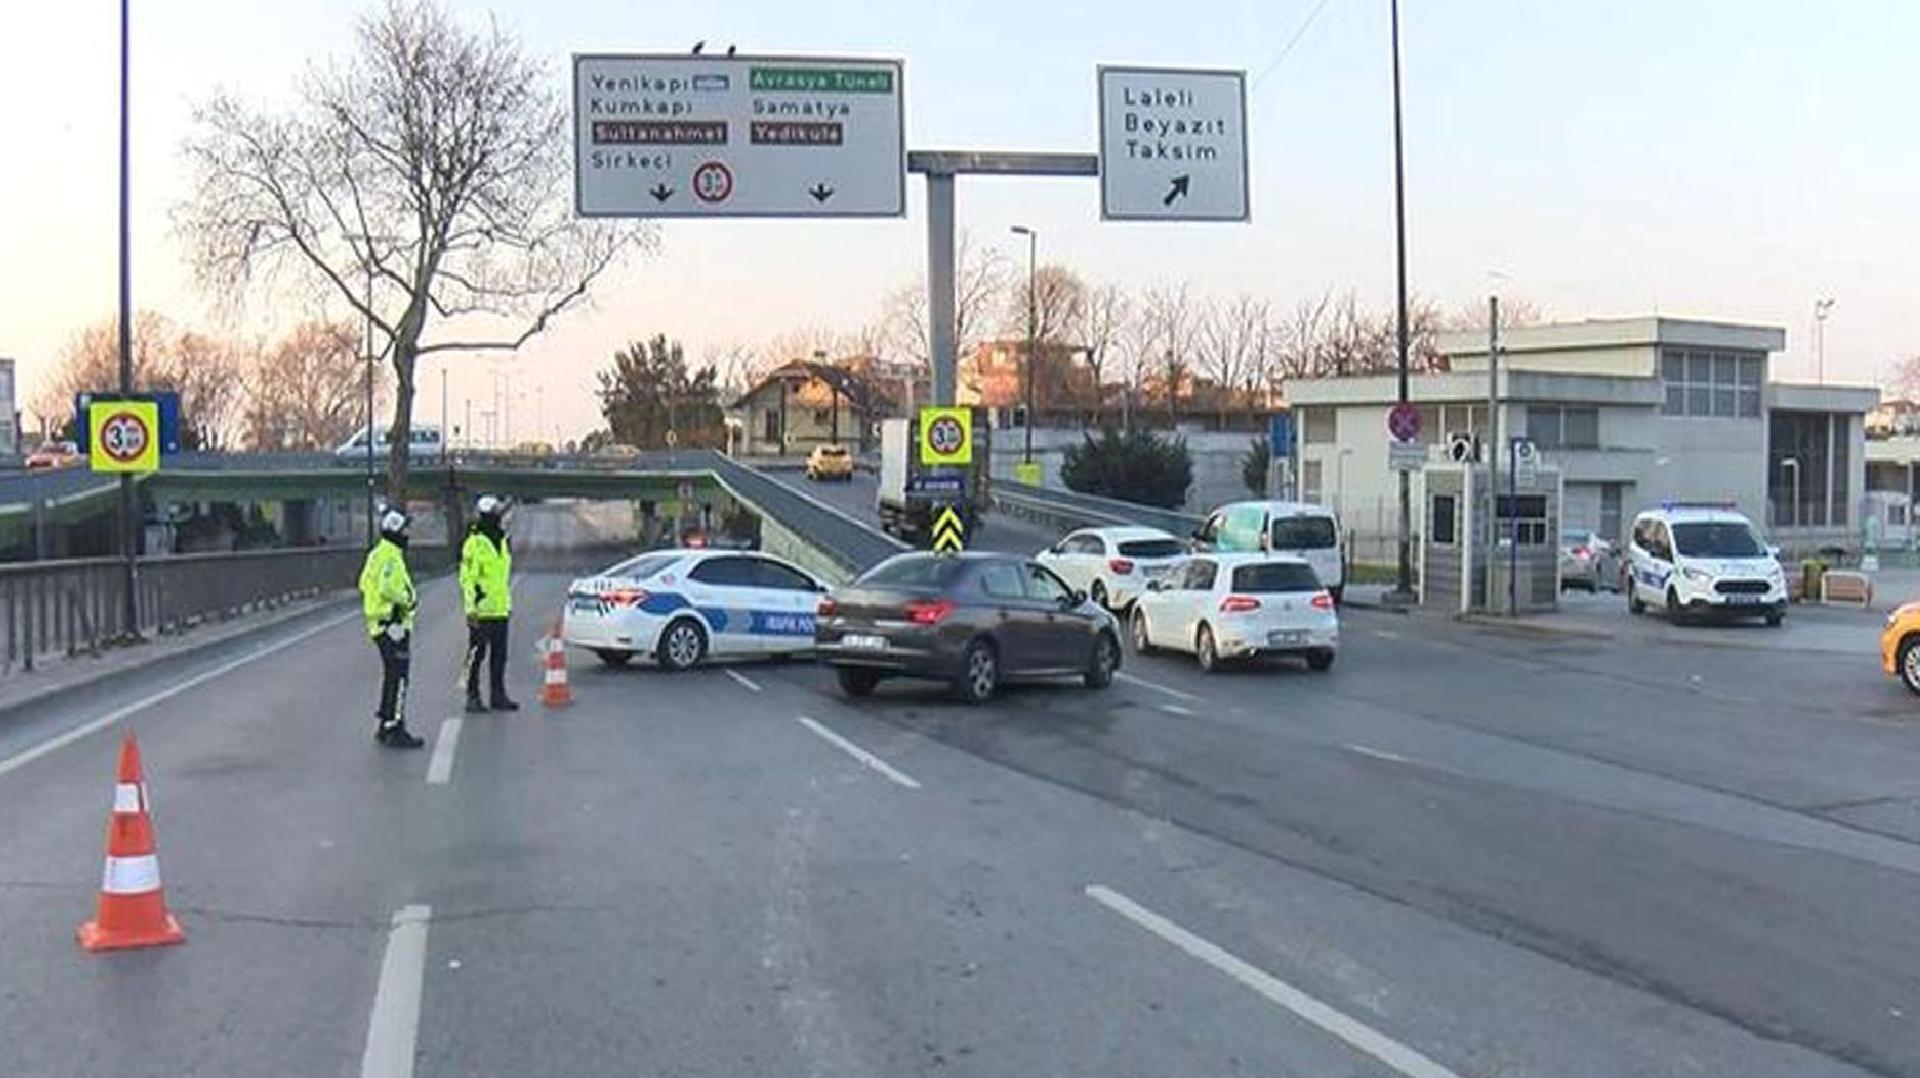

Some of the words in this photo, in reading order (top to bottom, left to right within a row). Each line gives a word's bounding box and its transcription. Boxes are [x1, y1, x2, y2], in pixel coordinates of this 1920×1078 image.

[1124, 87, 1192, 107] Laleli
[753, 99, 850, 117] Samatya
[595, 123, 724, 140] Sultanahmet
[756, 123, 839, 140] Yedikule
[1125, 112, 1224, 137] Beyazıt
[1126, 139, 1216, 159] Taksim
[591, 150, 672, 169] Sirkeci
